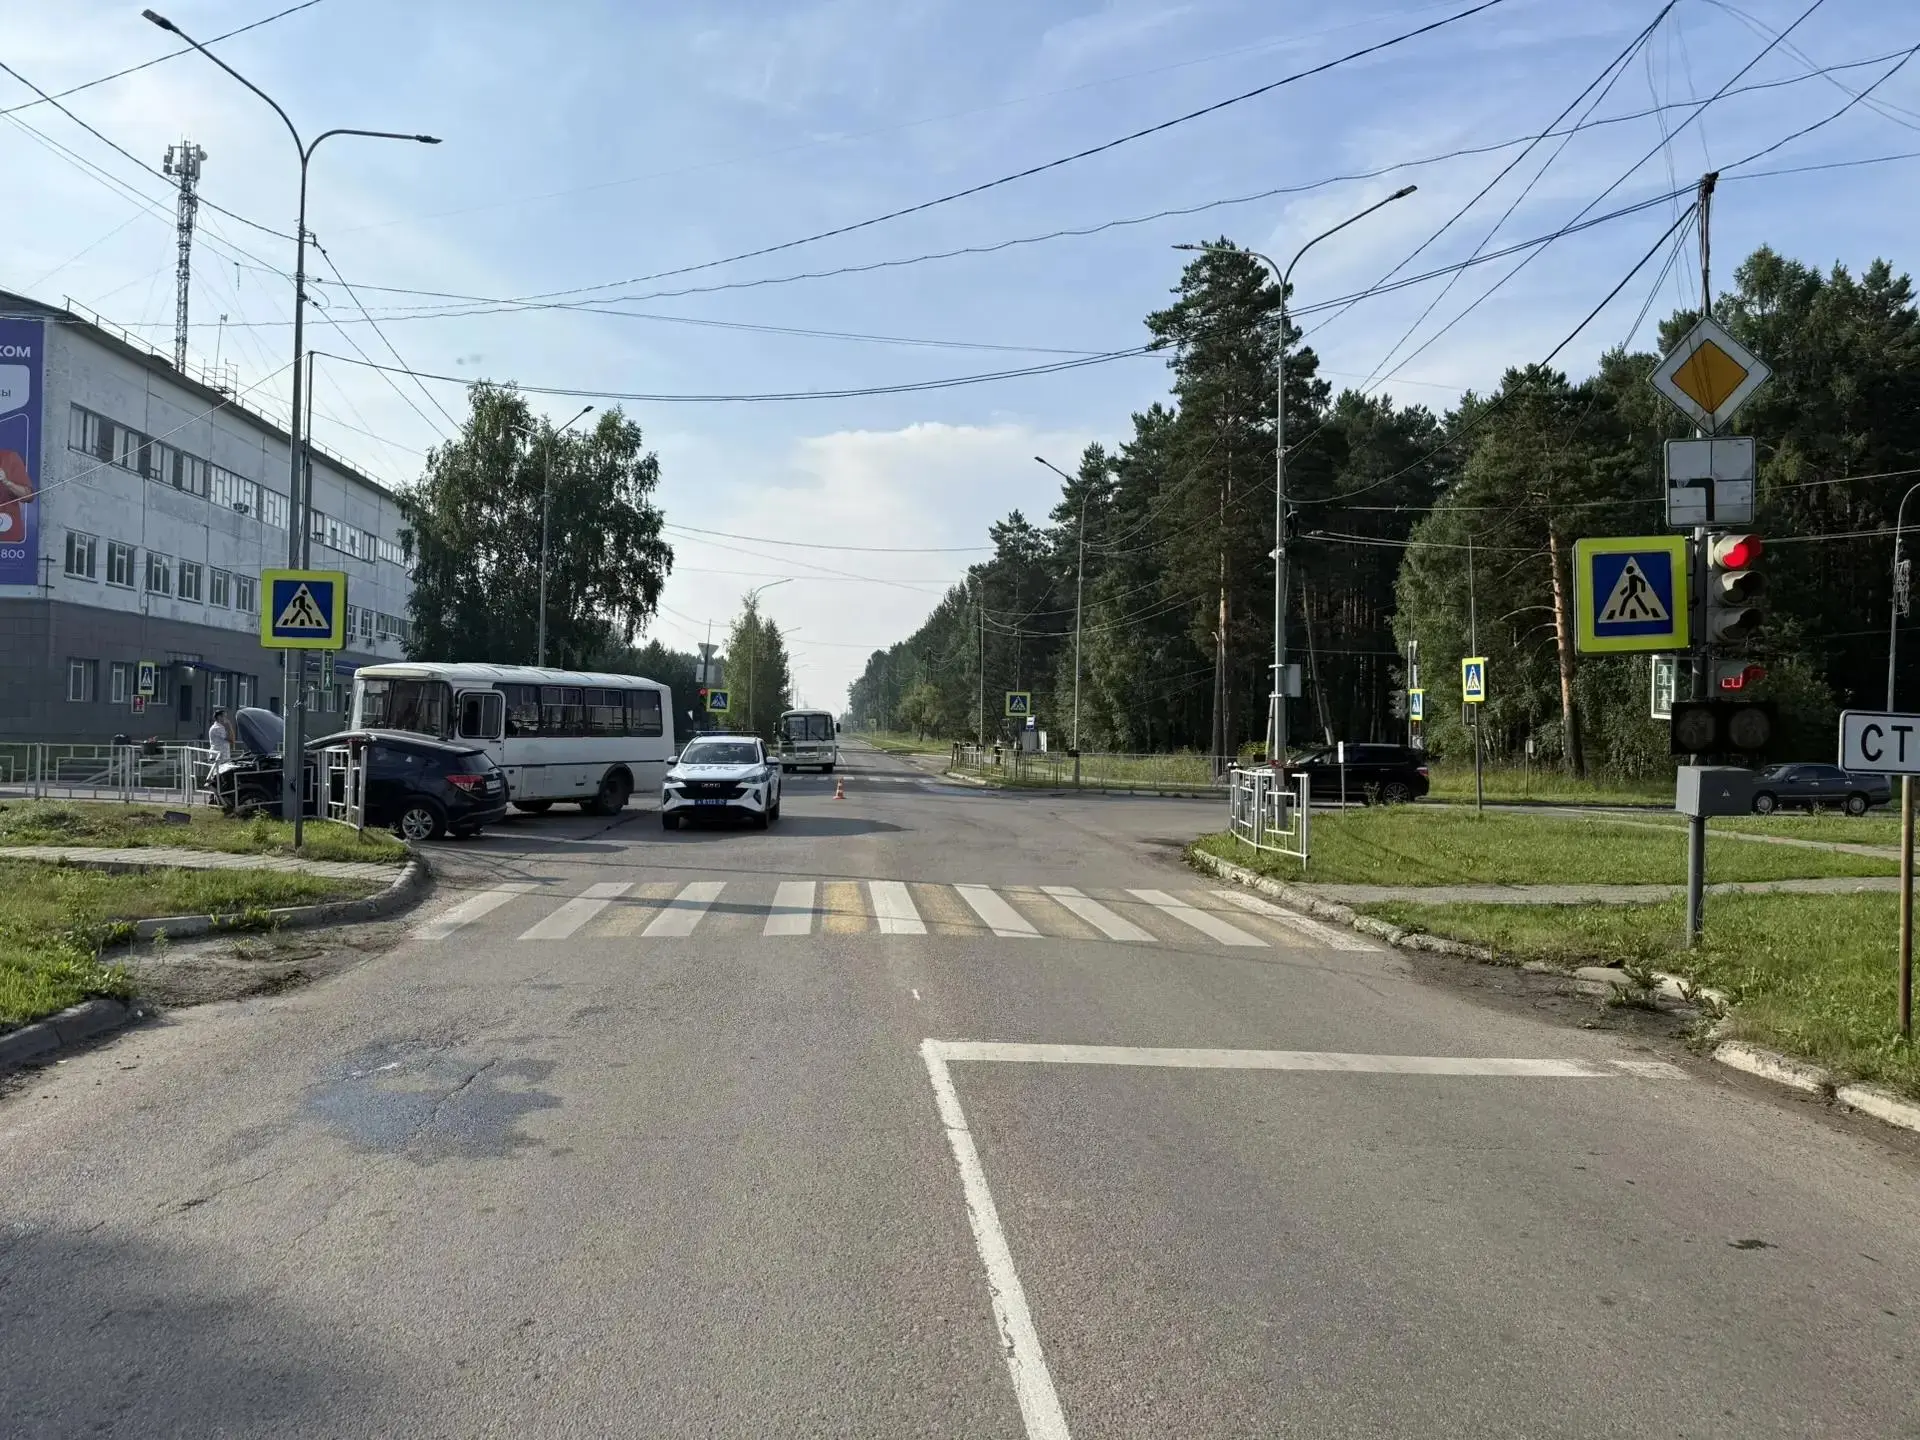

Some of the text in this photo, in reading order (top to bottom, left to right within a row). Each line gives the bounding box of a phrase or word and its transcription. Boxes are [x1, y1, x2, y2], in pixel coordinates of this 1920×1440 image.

[0, 389, 11, 397] ы
[1, 549, 25, 559] 800
[1861, 724, 1913, 762] СТ
